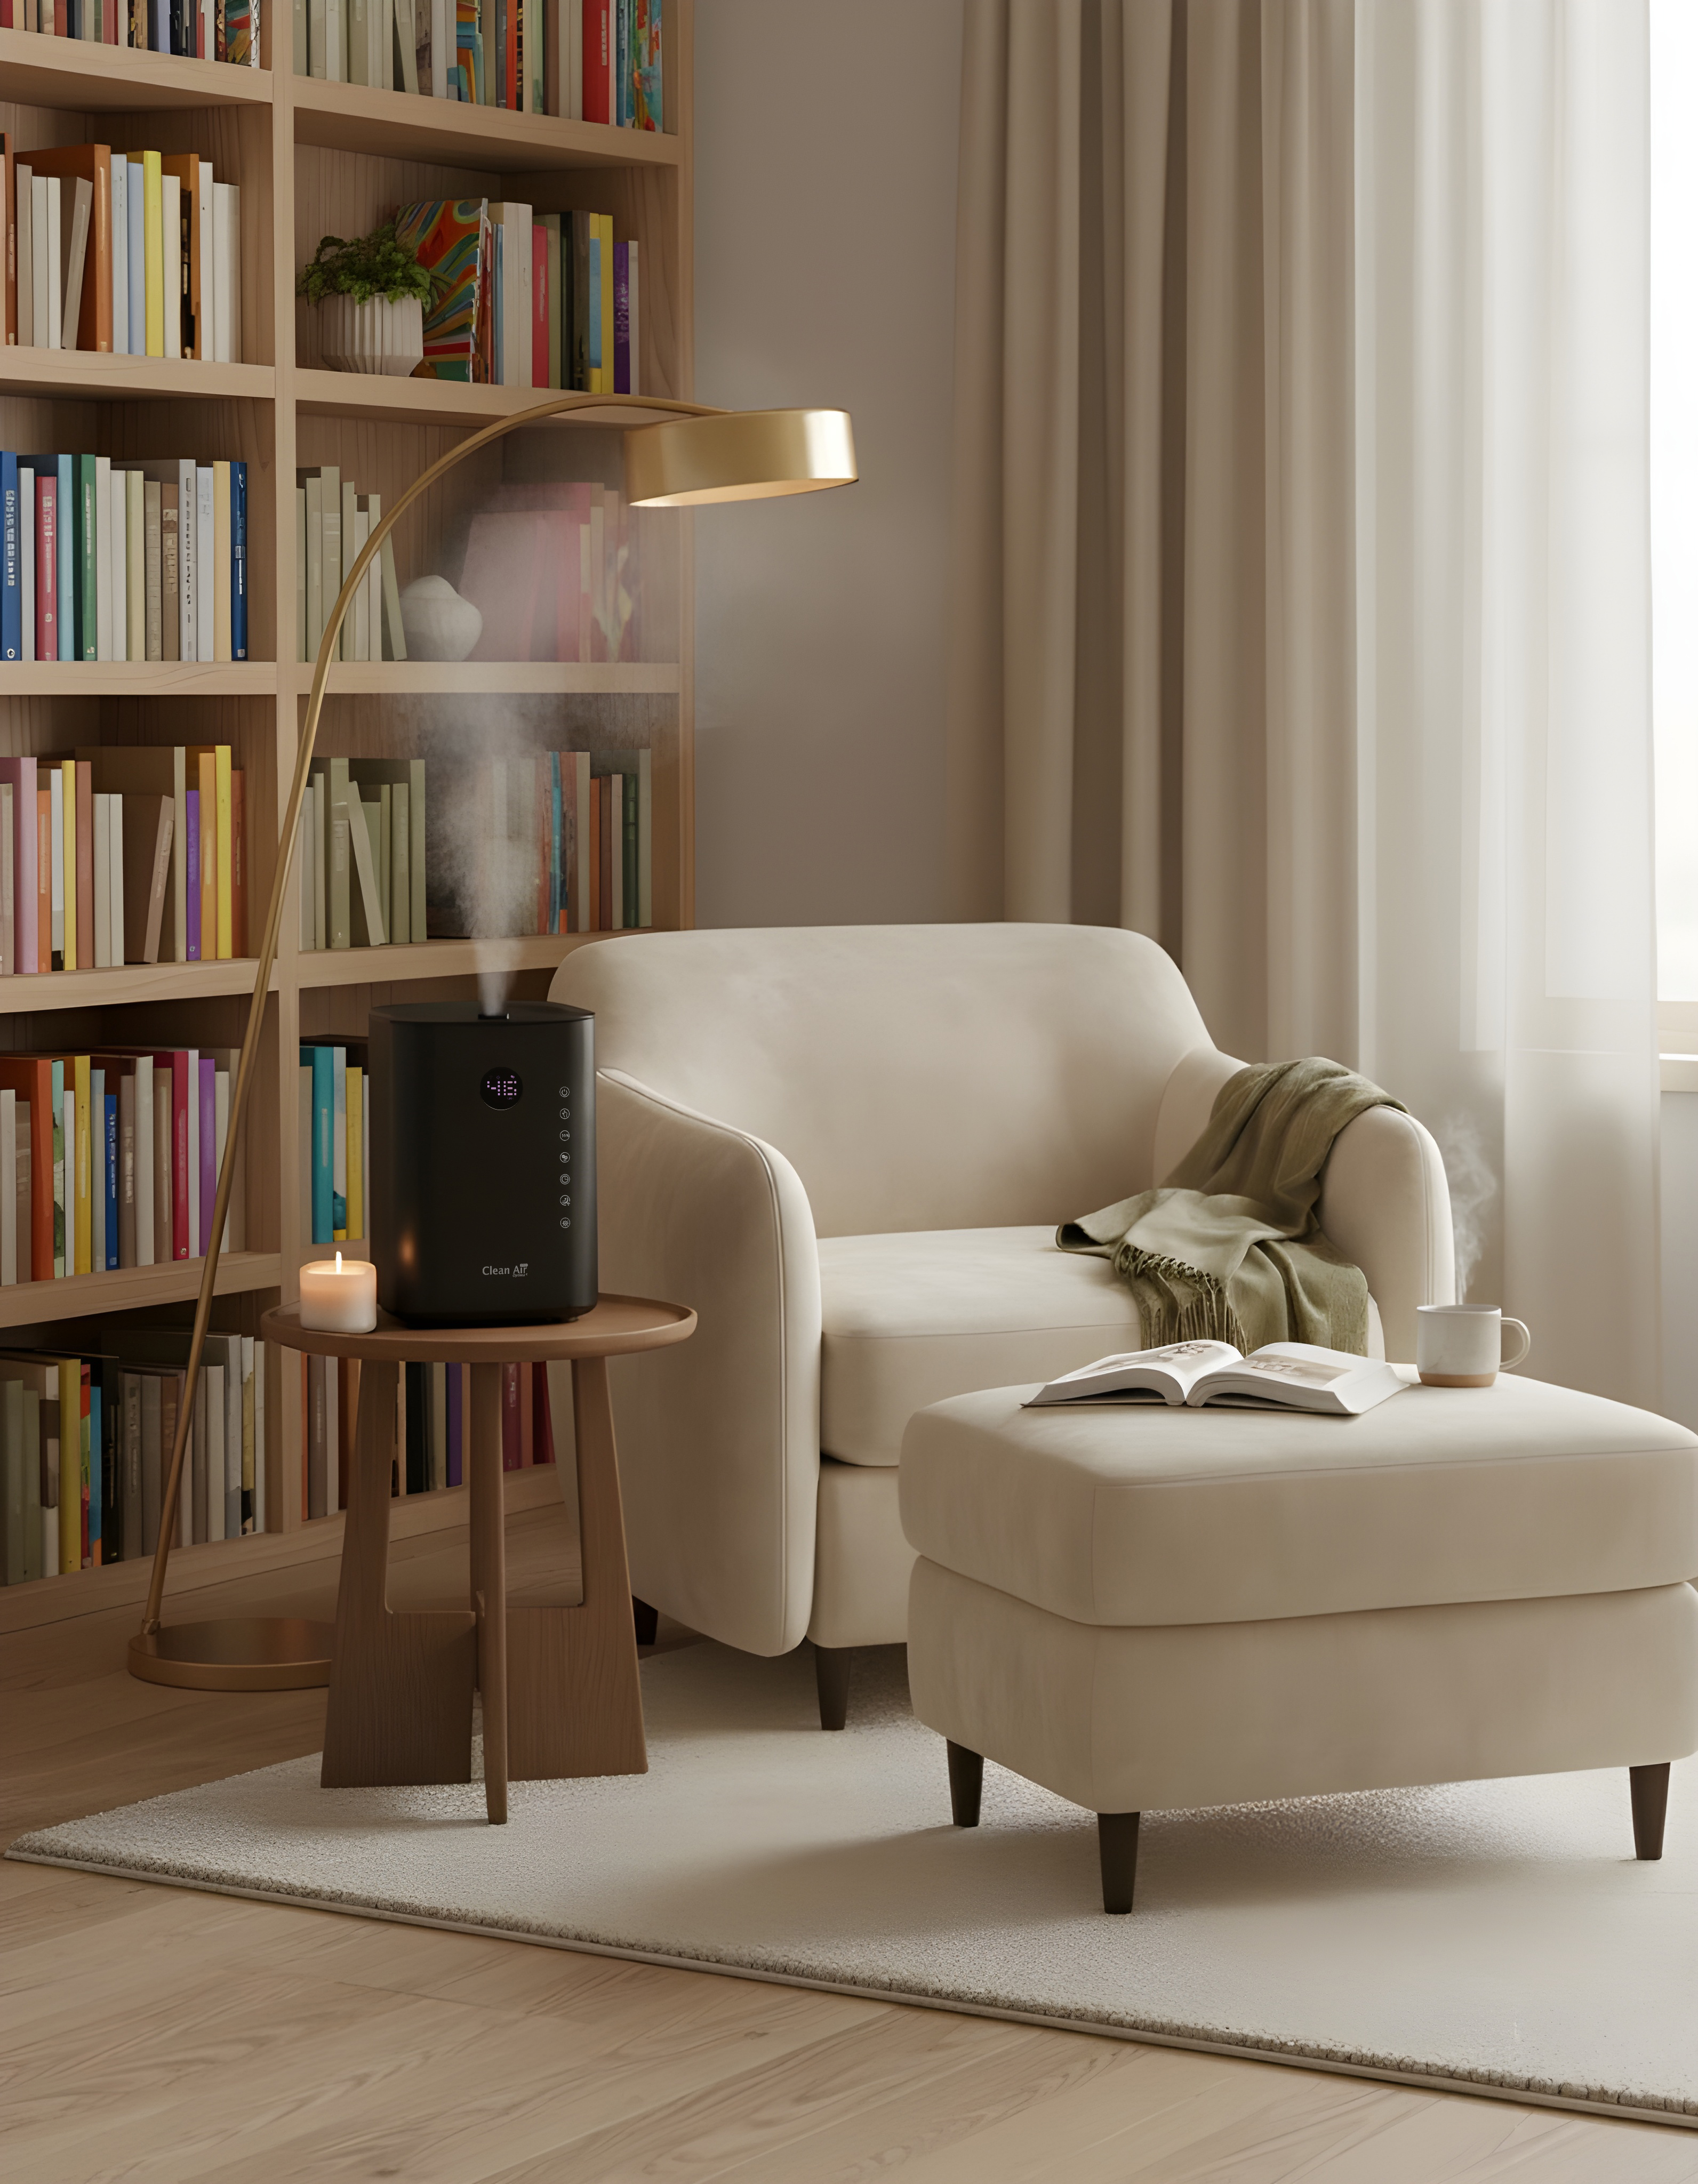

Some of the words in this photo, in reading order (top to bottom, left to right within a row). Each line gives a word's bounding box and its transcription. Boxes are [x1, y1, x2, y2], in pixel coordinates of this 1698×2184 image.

[487, 1081, 517, 1096] 46
[482, 1266, 510, 1275] Clean
[513, 1265, 527, 1274] Air
